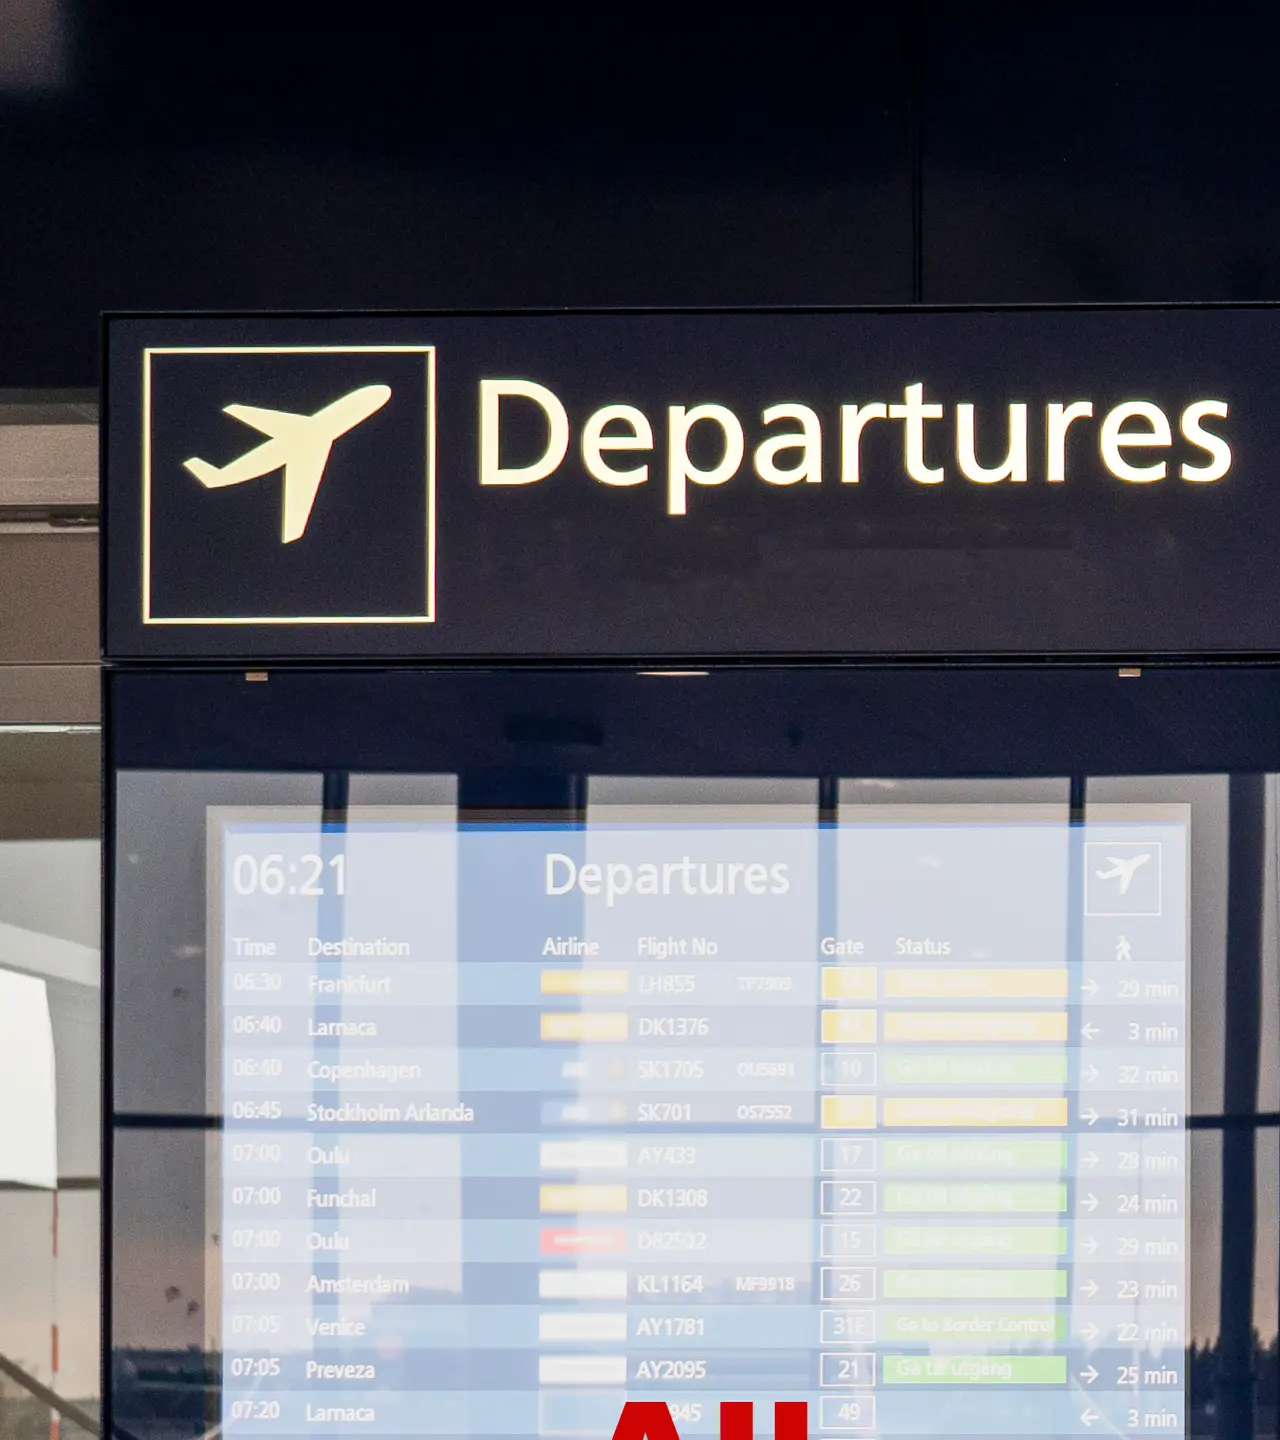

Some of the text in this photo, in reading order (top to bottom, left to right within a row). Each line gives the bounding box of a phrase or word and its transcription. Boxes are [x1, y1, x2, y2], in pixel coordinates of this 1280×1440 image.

[480, 380, 1231, 514] Departures
[232, 852, 347, 896] 06:21
[546, 853, 790, 908] Departures
[231, 935, 952, 960] Time Destination Airline Flight No Gate Status
